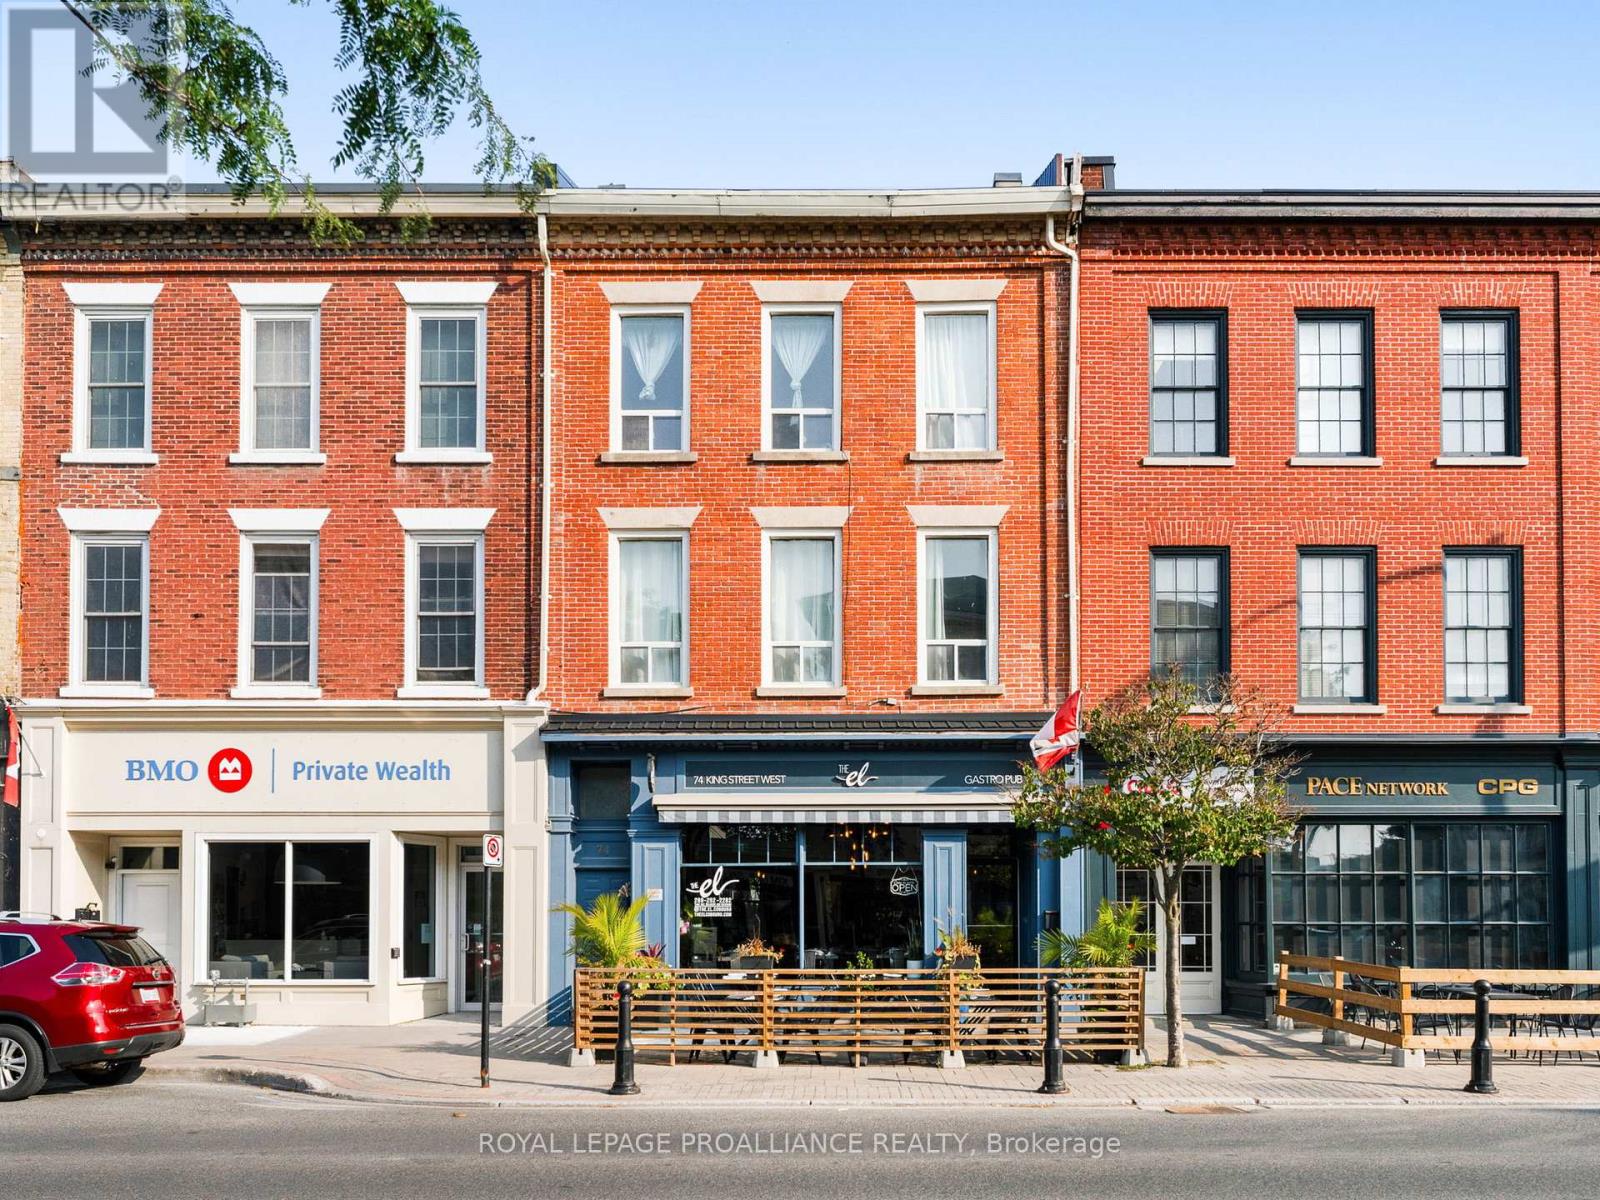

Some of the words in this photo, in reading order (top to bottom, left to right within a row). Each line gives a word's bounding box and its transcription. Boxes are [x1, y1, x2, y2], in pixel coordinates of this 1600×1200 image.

[125, 760, 199, 781] BMO
[292, 760, 368, 781] Private
[376, 760, 450, 781] Wealth
[838, 764, 850, 774] THE
[693, 775, 704, 785] 74
[705, 775, 728, 785] KING
[728, 775, 760, 785] STREET
[760, 774, 786, 784] WEST
[964, 774, 1004, 785] GASTRO
[1004, 774, 1024, 785] PUB
[1306, 777, 1362, 796] PACE
[1366, 782, 1448, 796] NETWORK
[1477, 778, 1539, 795] CPG
[892, 883, 917, 892] OPEN
